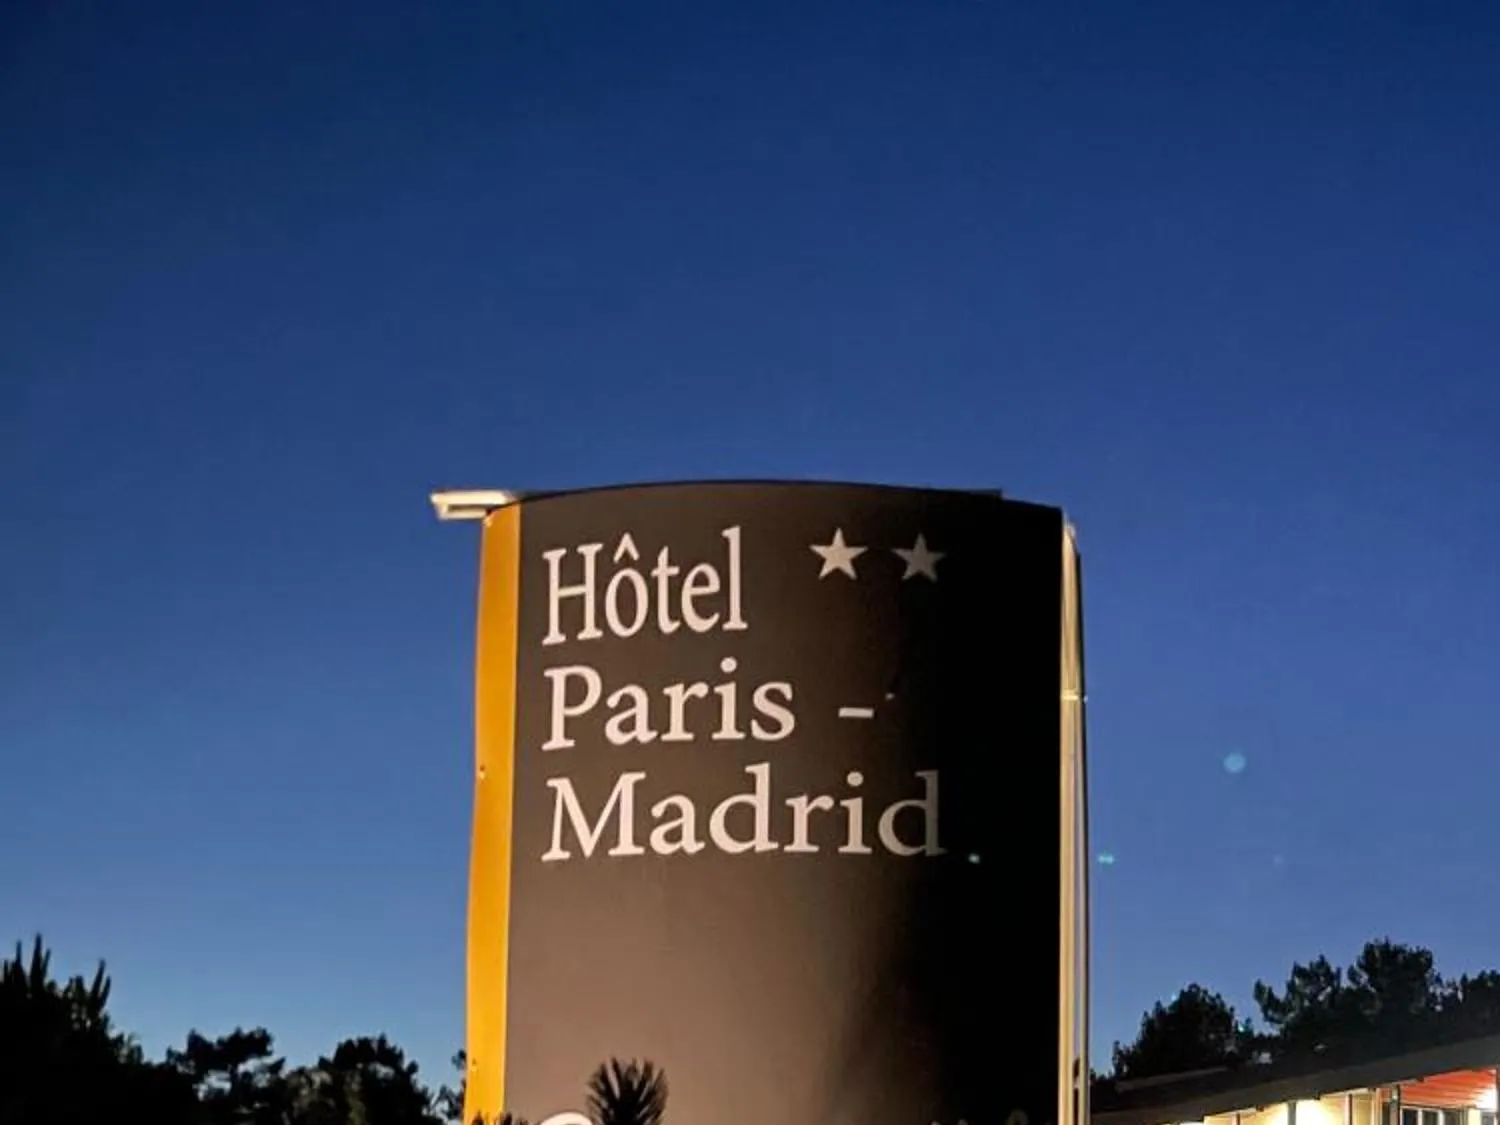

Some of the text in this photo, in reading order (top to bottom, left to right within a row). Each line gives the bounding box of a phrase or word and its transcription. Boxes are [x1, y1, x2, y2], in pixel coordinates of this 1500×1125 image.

[541, 526, 748, 646] Hôtel
[541, 657, 796, 751] Paris
[541, 762, 946, 861] Madrid
